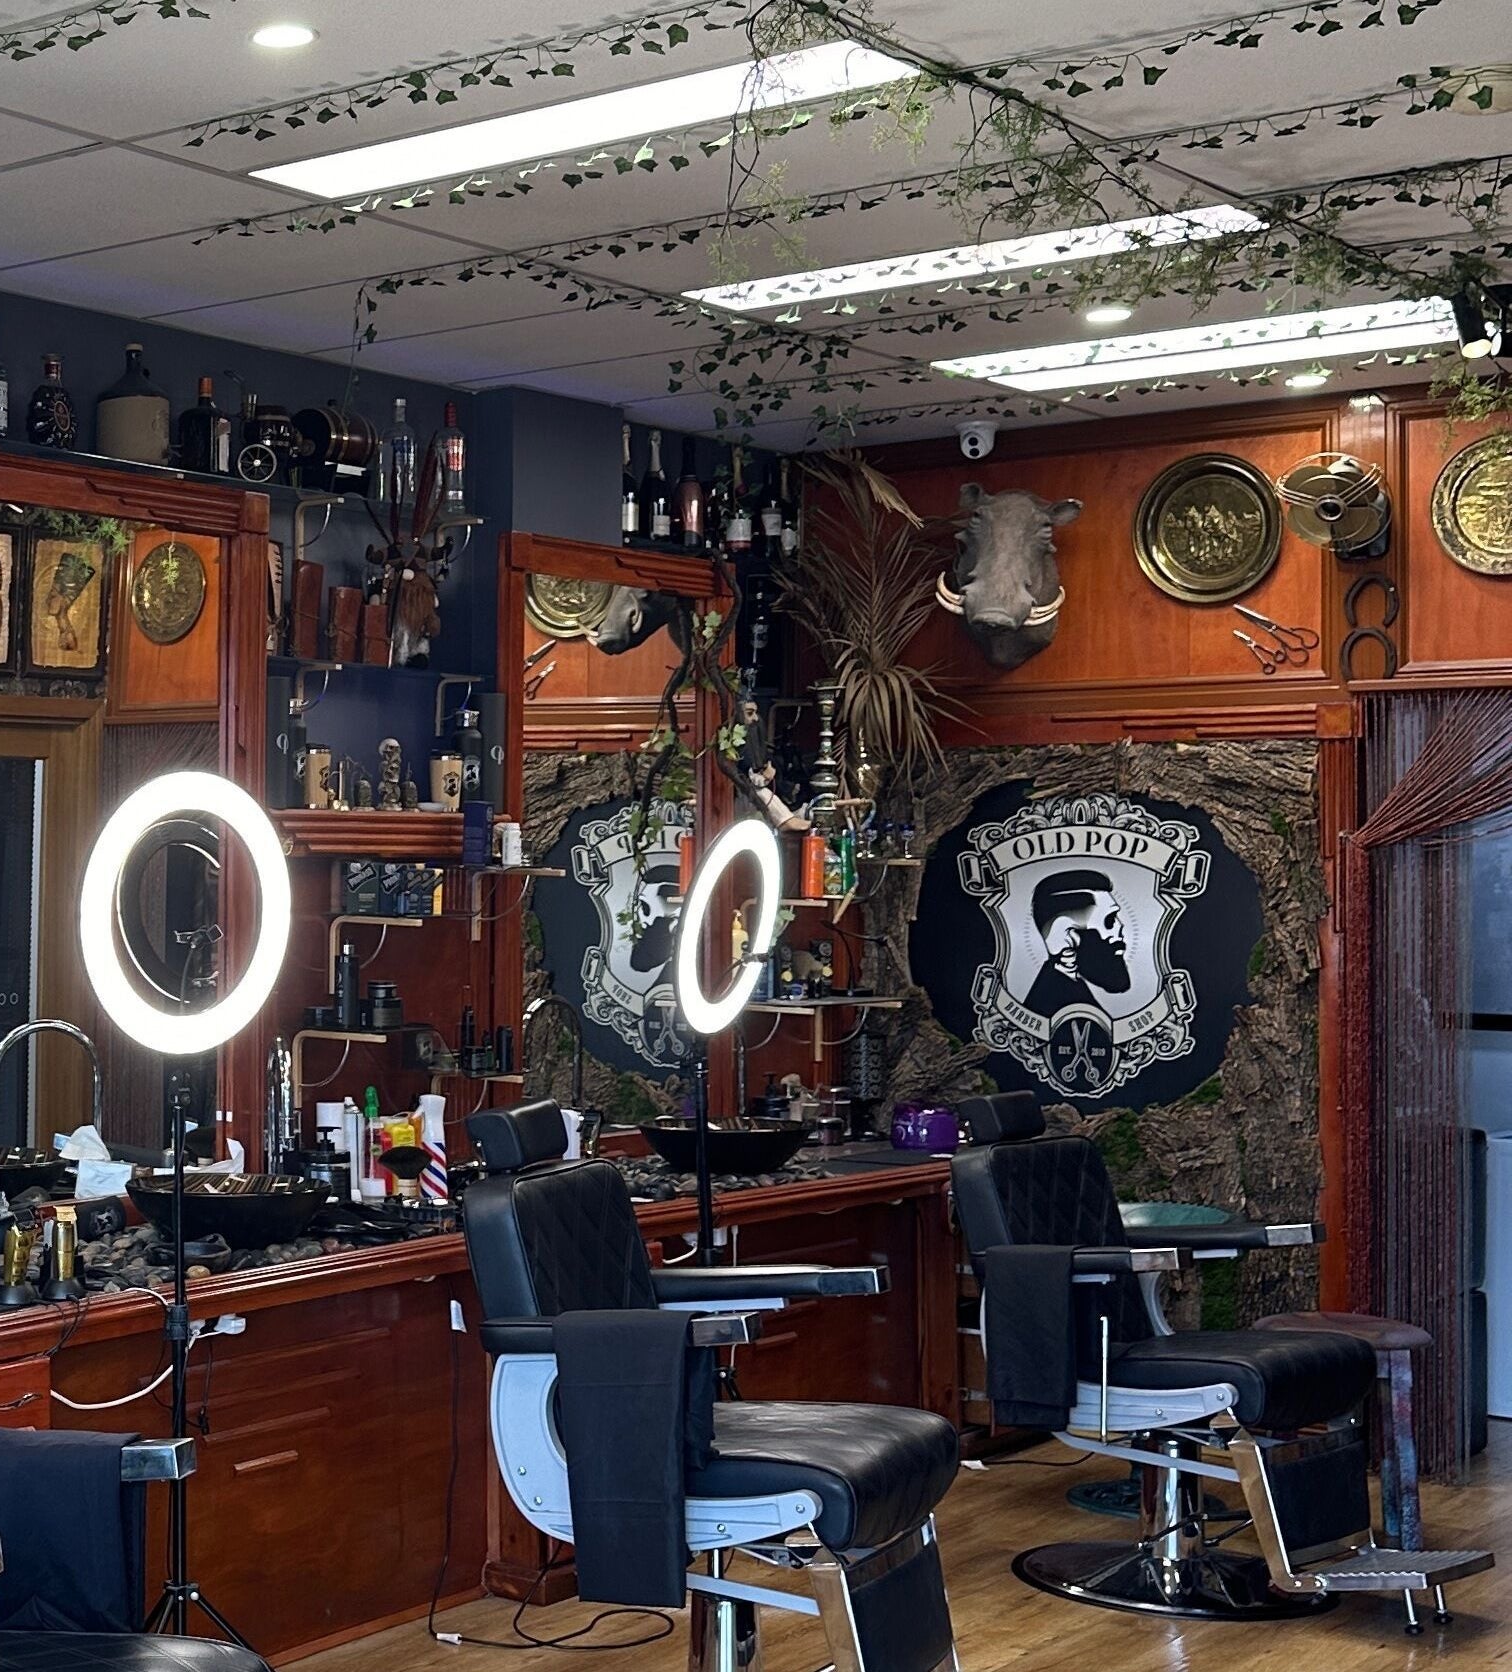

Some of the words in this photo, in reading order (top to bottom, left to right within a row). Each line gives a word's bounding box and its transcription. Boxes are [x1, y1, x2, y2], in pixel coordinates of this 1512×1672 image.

[1012, 831, 1076, 859] OLD
[1086, 830, 1149, 860] POP
[1004, 1001, 1042, 1032] BARBER
[1128, 1010, 1154, 1034] SHOP
